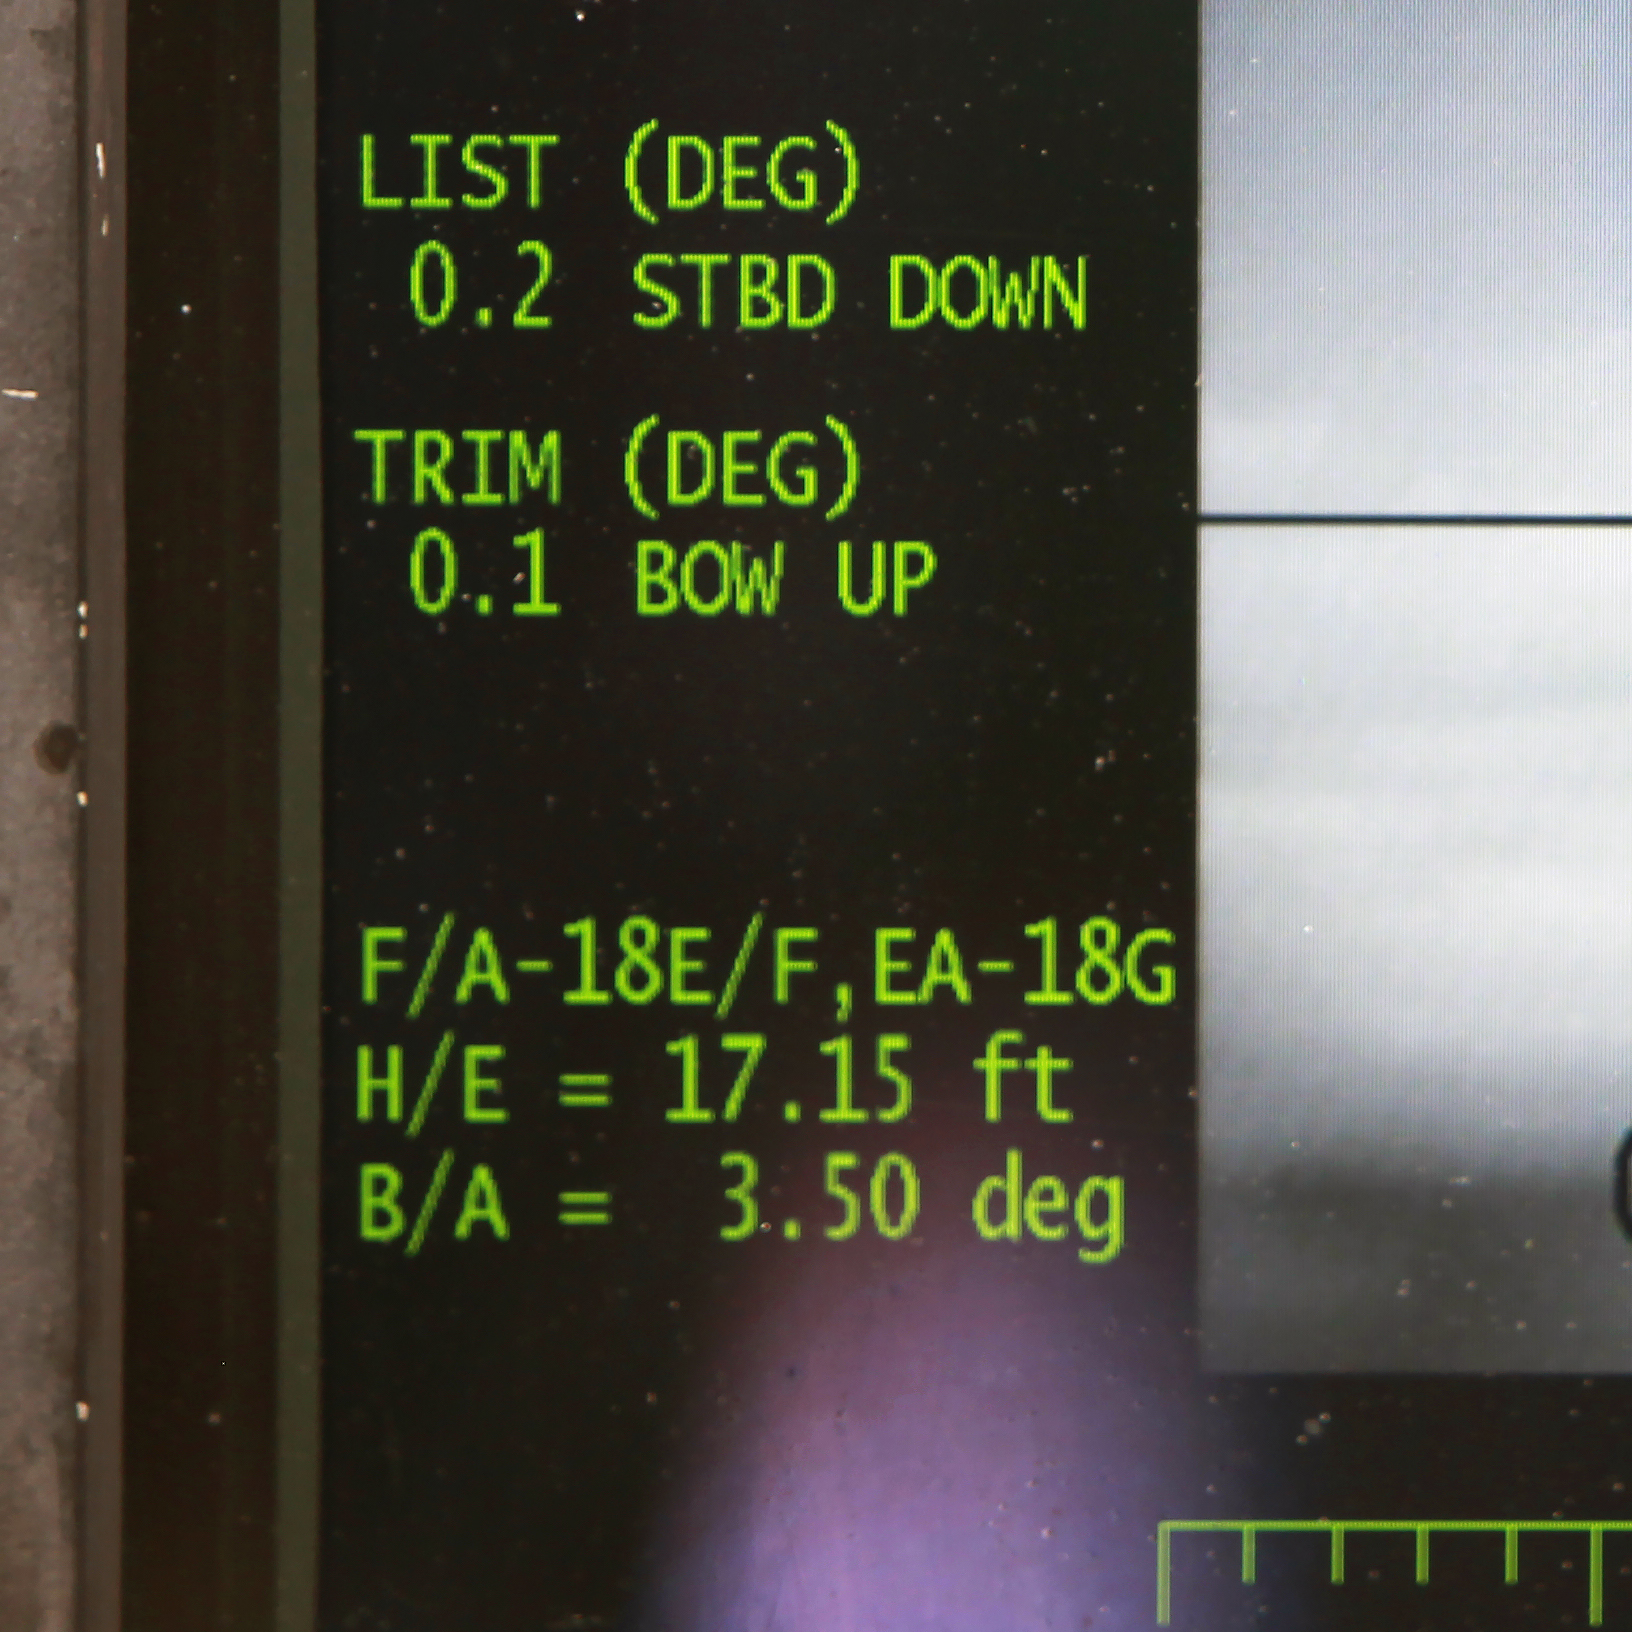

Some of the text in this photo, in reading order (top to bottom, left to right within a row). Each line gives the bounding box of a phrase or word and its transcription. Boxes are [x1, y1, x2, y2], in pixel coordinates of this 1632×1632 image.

[362, 119, 859, 224] LIST (DEG)
[410, 240, 1086, 329] 0.2 STBD DOWN
[354, 415, 860, 519] TRIM (DEG)
[410, 527, 937, 616] 0.1 BOW UP
[363, 915, 1175, 1018] F/A-18E/F,EA-18G
[358, 1031, 1071, 1132] H/E = 17.15 ft
[361, 1151, 1124, 1262] B/A = 3.50 deg
